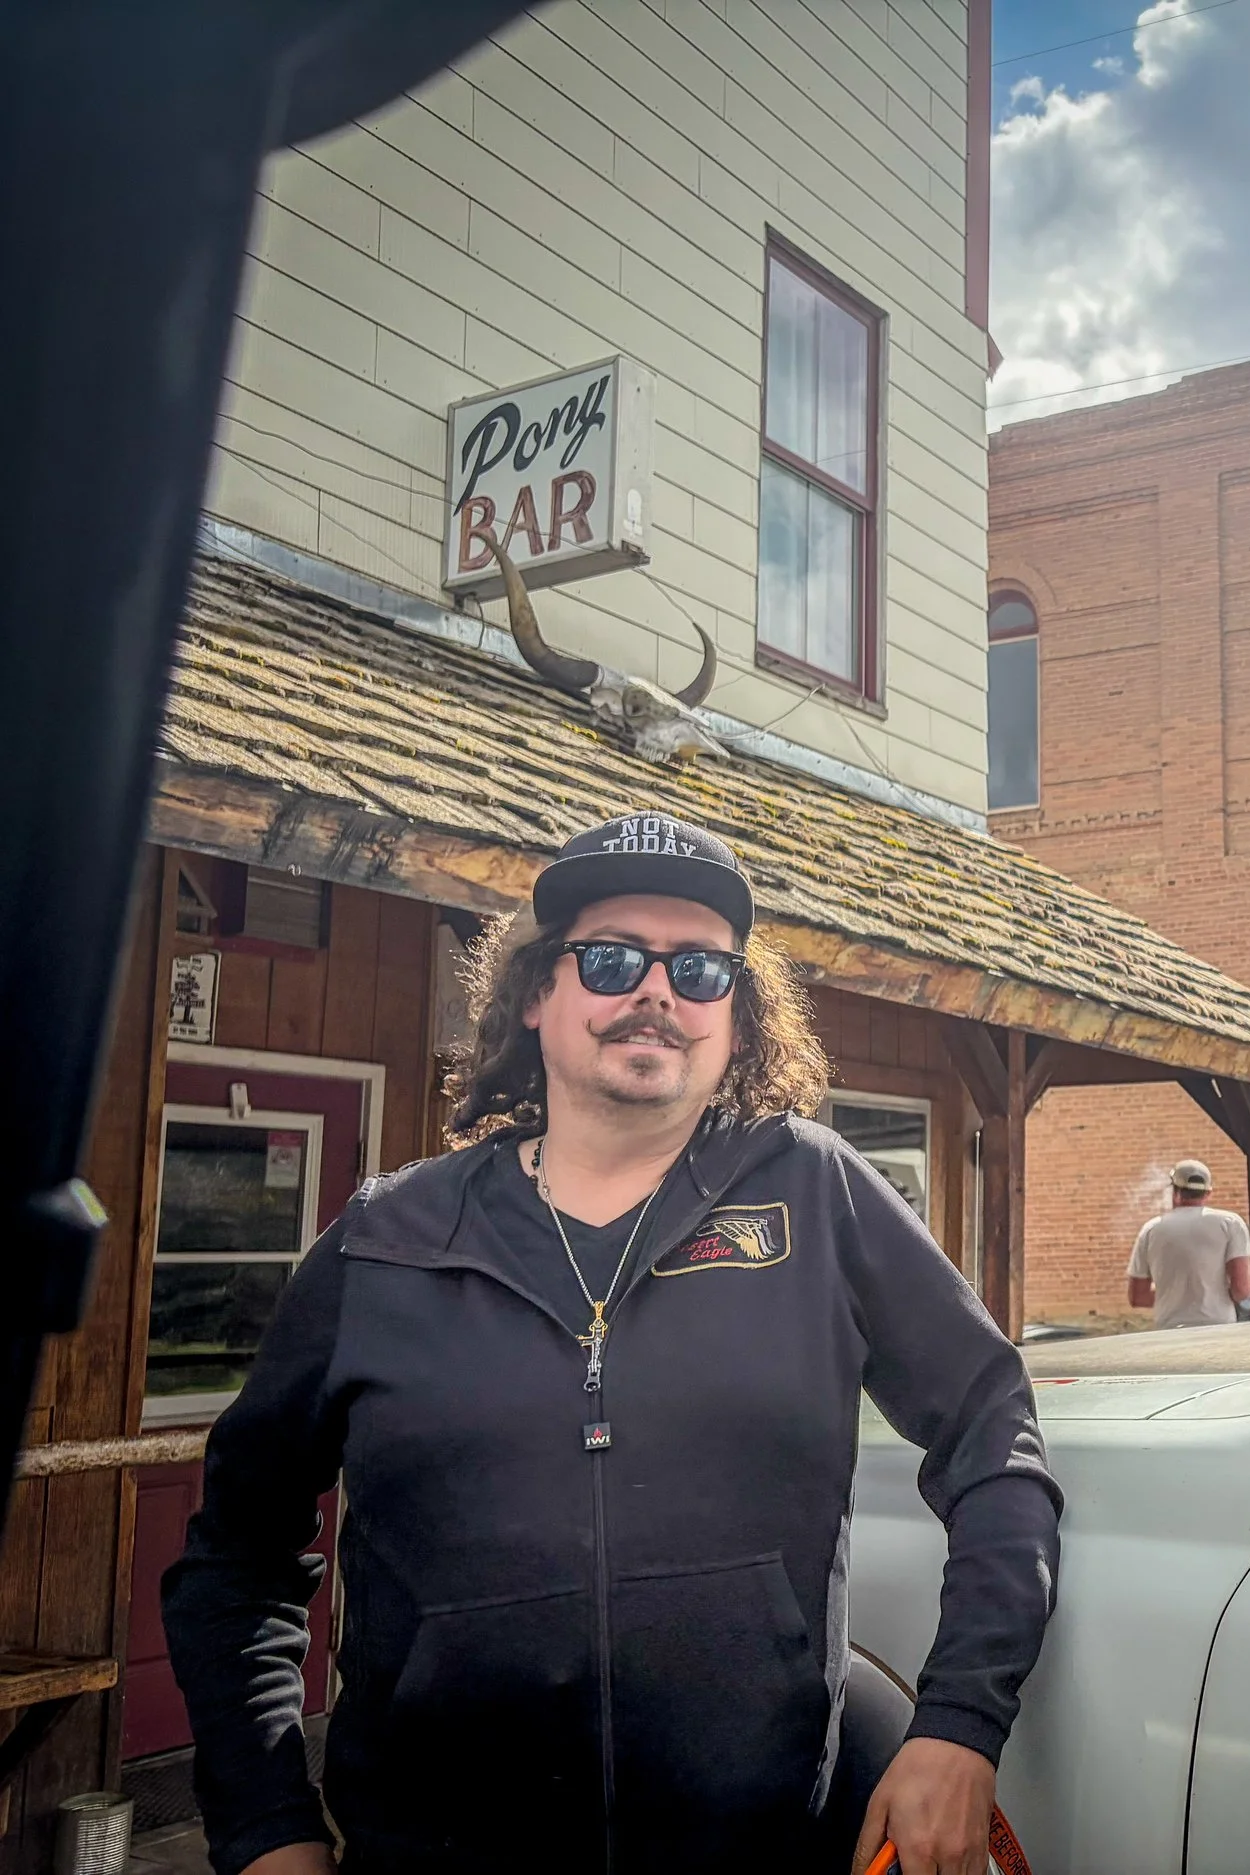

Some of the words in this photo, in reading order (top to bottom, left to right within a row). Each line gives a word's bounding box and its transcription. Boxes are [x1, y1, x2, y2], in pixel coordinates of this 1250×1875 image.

[453, 375, 611, 516] Pony
[457, 470, 596, 574] BAR
[620, 818, 679, 839] NOT
[603, 835, 696, 856] TODAY
[690, 1246, 733, 1261] Eagle
[586, 1436, 610, 1446] IWI
